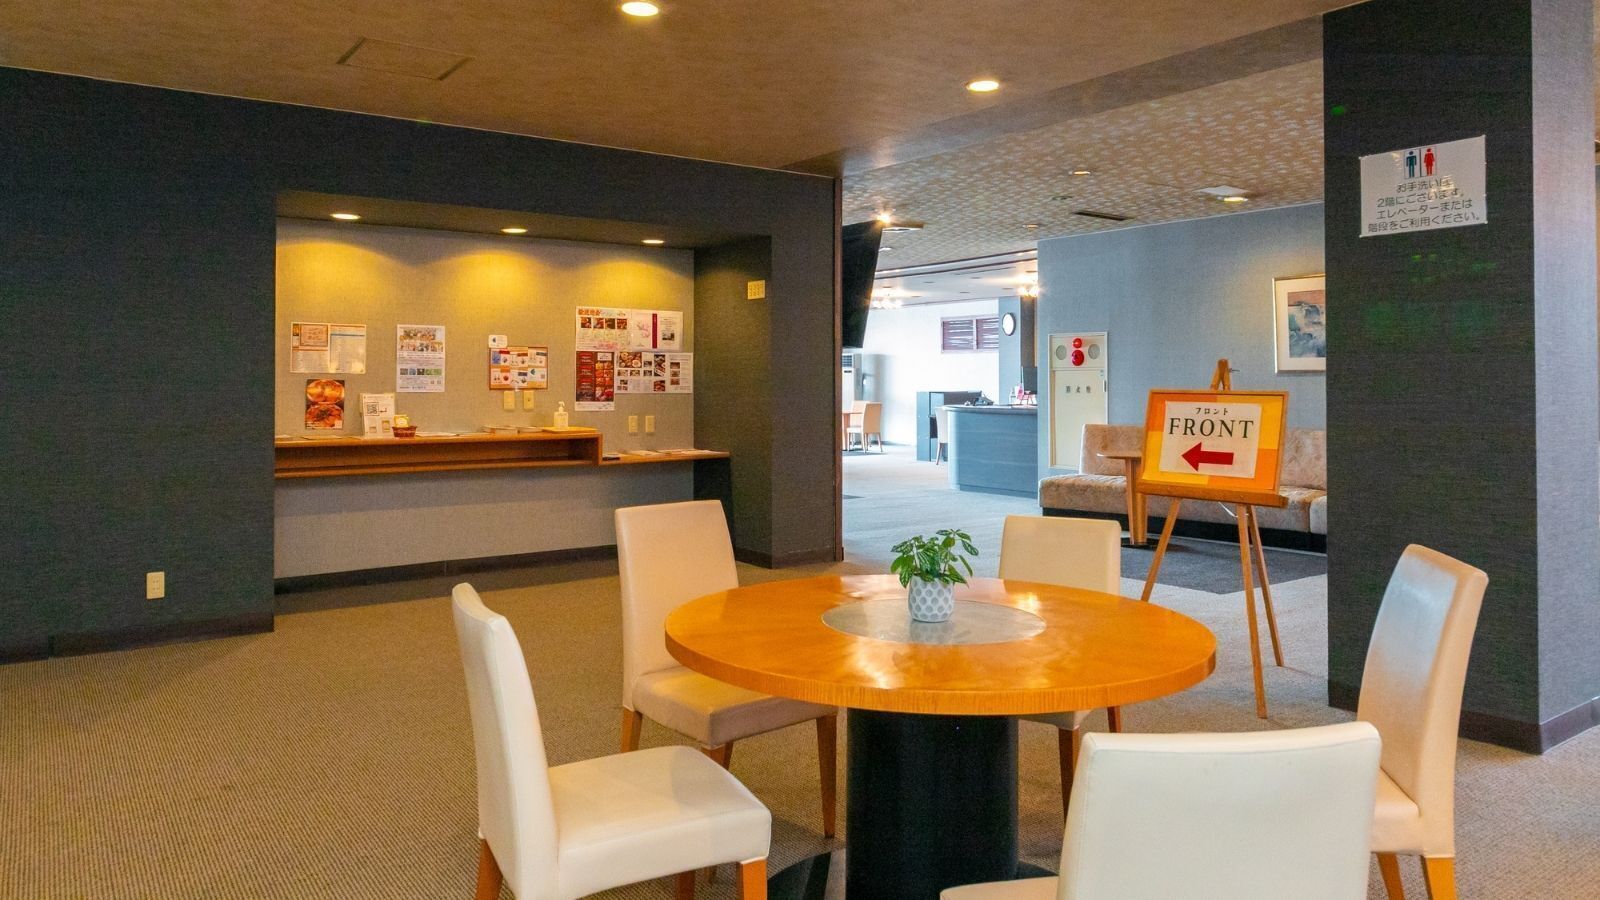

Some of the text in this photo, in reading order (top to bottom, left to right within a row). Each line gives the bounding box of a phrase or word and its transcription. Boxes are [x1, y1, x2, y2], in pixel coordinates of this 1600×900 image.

[1396, 179, 1451, 193] お手洗いは
[1376, 198, 1472, 219] エレベーターまたは
[1367, 212, 1480, 232] 階段をご利用ください。
[1195, 407, 1229, 416] フロント
[1168, 417, 1254, 439] FRONT
